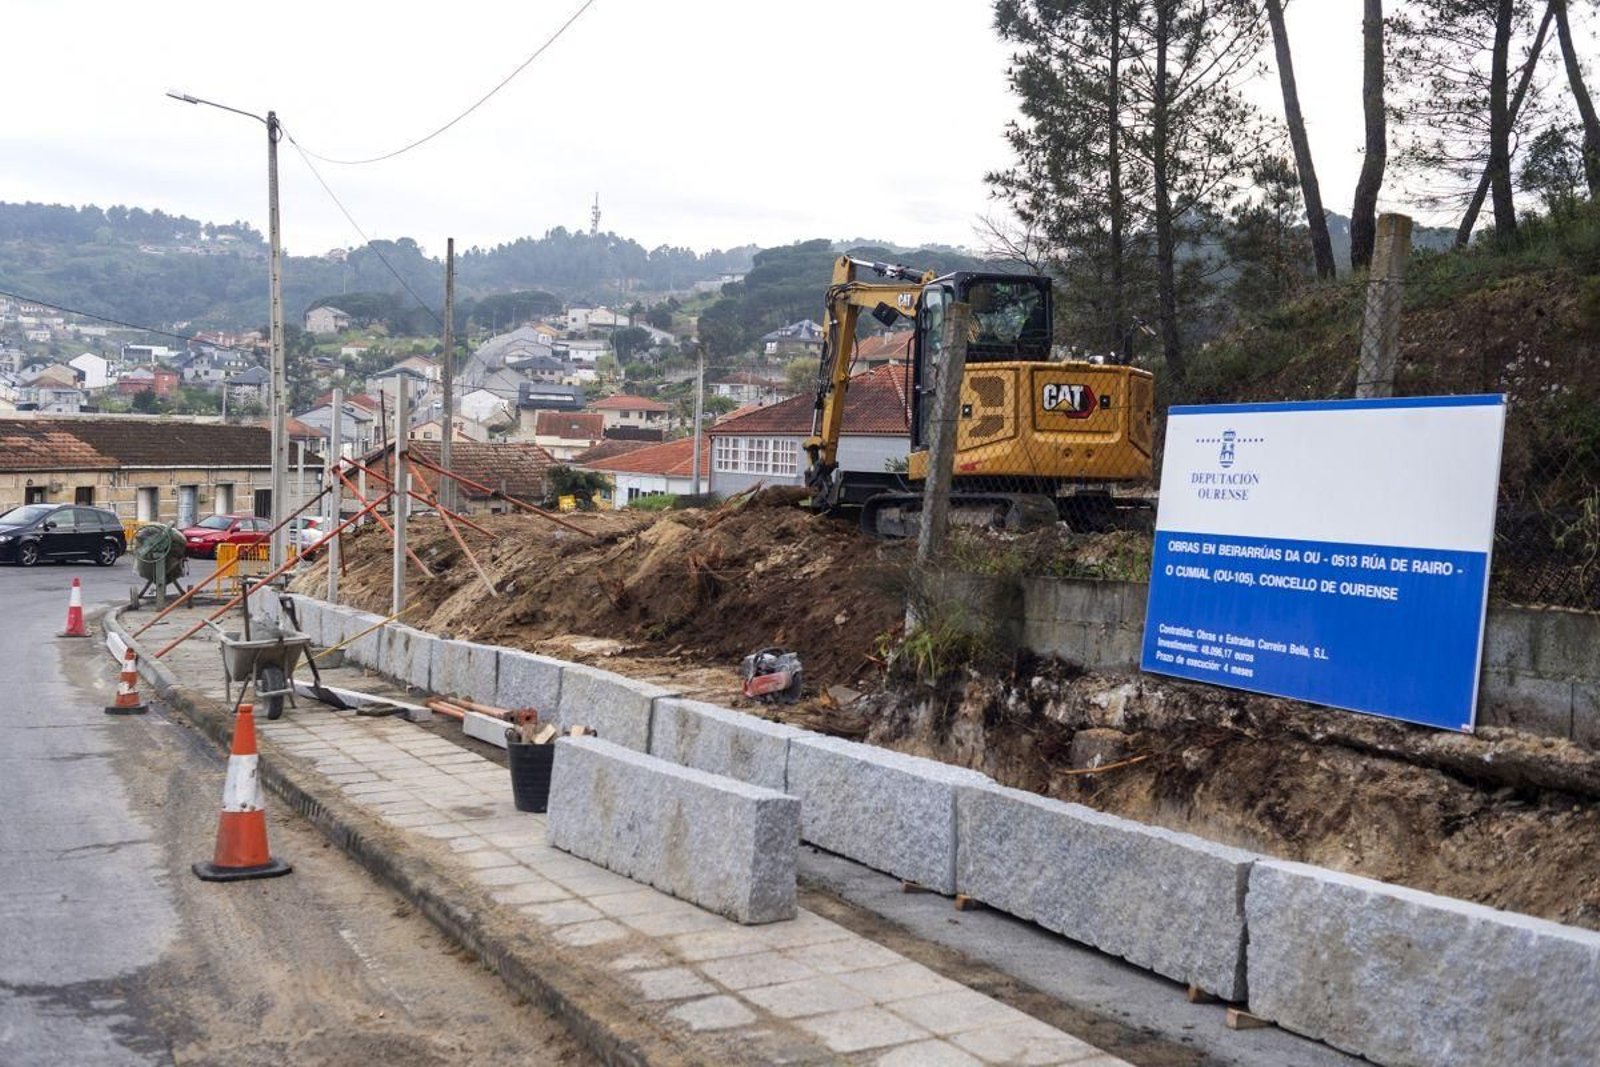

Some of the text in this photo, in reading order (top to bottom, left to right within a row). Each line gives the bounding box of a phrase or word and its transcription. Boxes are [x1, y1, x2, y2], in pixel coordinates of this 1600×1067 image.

[897, 292, 912, 307] CAT
[1043, 383, 1084, 411] CAT
[1191, 471, 1259, 485] DEPUTACIÓN
[1198, 488, 1249, 501] OURENSE
[1168, 540, 1200, 554] OBRAS
[1202, 543, 1216, 555] EN
[1218, 544, 1282, 561] BEIRARRÚAS
[1285, 550, 1300, 562] DA
[1303, 551, 1320, 564] OU
[1331, 554, 1357, 568] 0513
[1361, 553, 1386, 570] RÚA
[1390, 558, 1408, 572] DE
[1412, 560, 1453, 576] RAIRO
[1165, 564, 1398, 600] O CUMIAL (OU-105). CONCELLO DE OURENSE
[1159, 623, 1195, 638] Contratista:
[1196, 629, 1216, 642] Obras
[1218, 634, 1223, 643] e
[1226, 634, 1255, 648] Estradas
[1258, 639, 1287, 653] Carreira
[1313, 647, 1329, 660] S.L.
[1156, 650, 1174, 662] Prazo
[1176, 652, 1185, 664] de
[1223, 663, 1229, 673] 4
[1231, 666, 1254, 678] meses
[1234, 652, 1254, 663] euros
